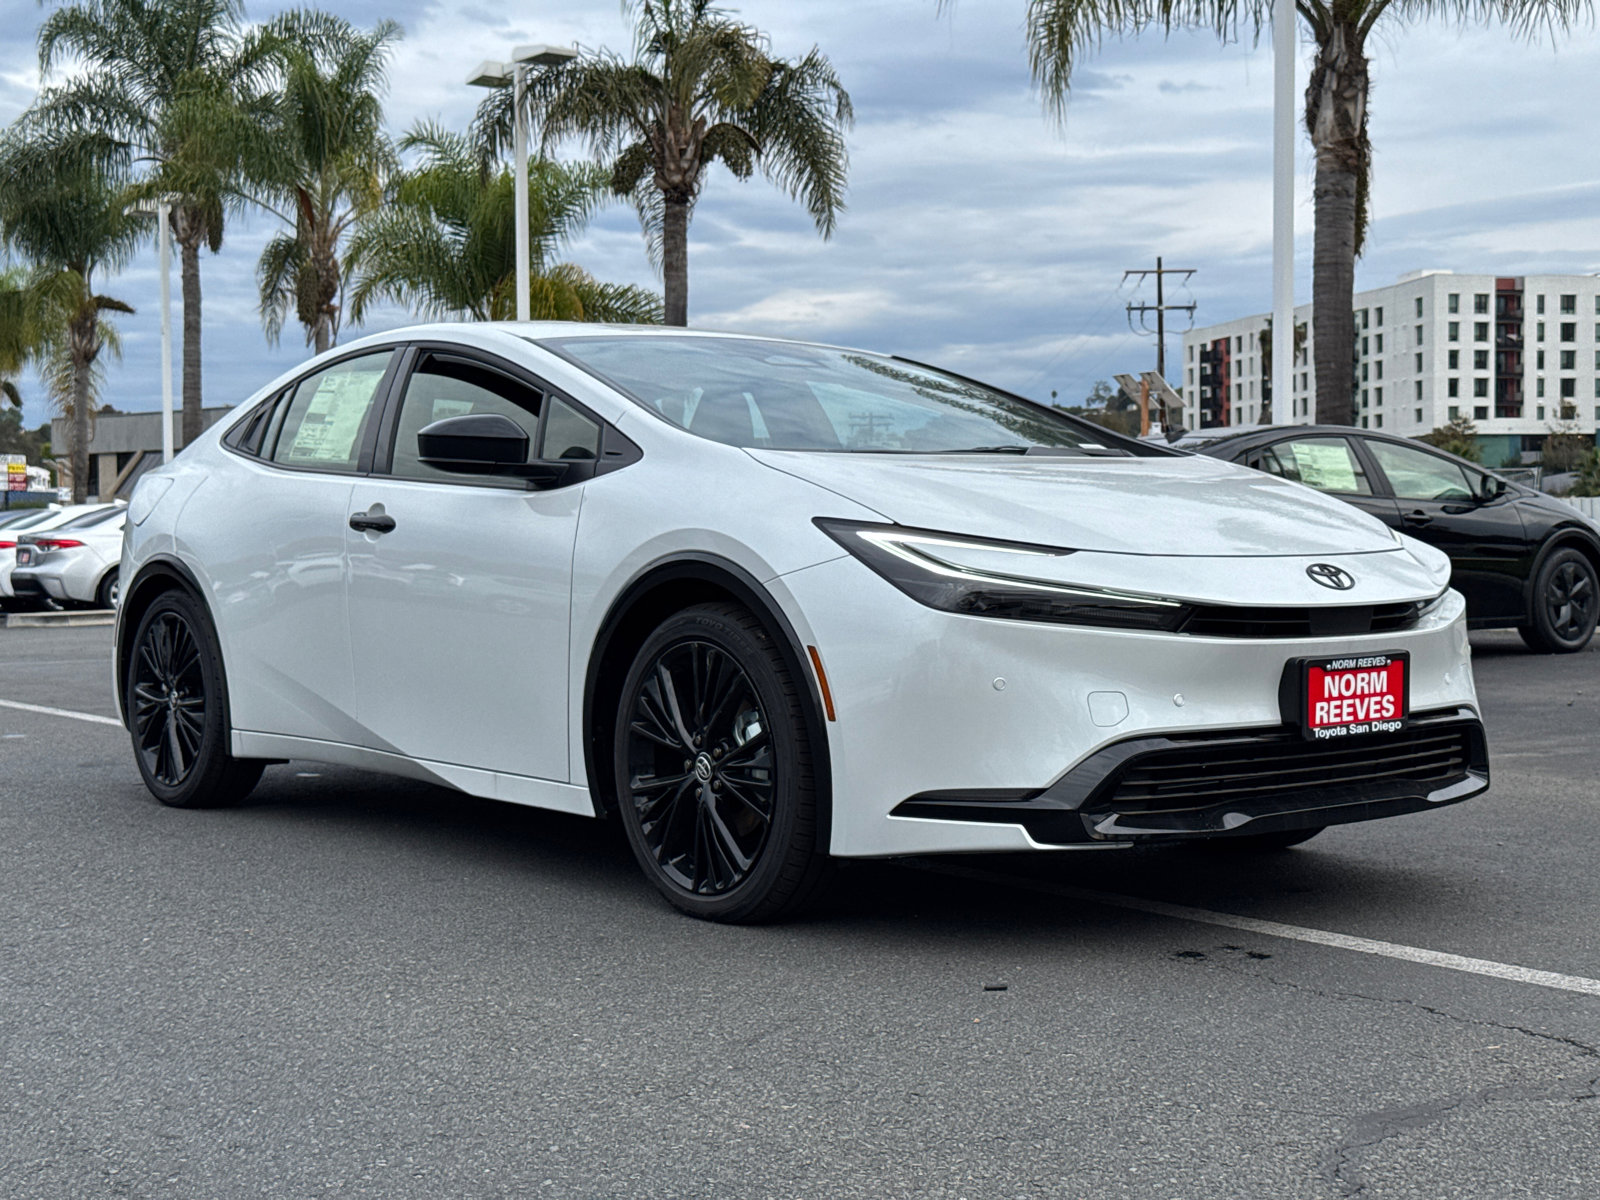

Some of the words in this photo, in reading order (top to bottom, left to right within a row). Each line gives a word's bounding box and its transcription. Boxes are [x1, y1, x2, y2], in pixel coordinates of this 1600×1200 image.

[1331, 659, 1357, 670] NORM
[1357, 656, 1386, 668] REEVES
[1324, 671, 1387, 698] NORM
[1315, 695, 1395, 725] REEVES
[1313, 727, 1347, 739] Toyota
[1349, 723, 1369, 734] San
[1371, 721, 1402, 733] Diego
